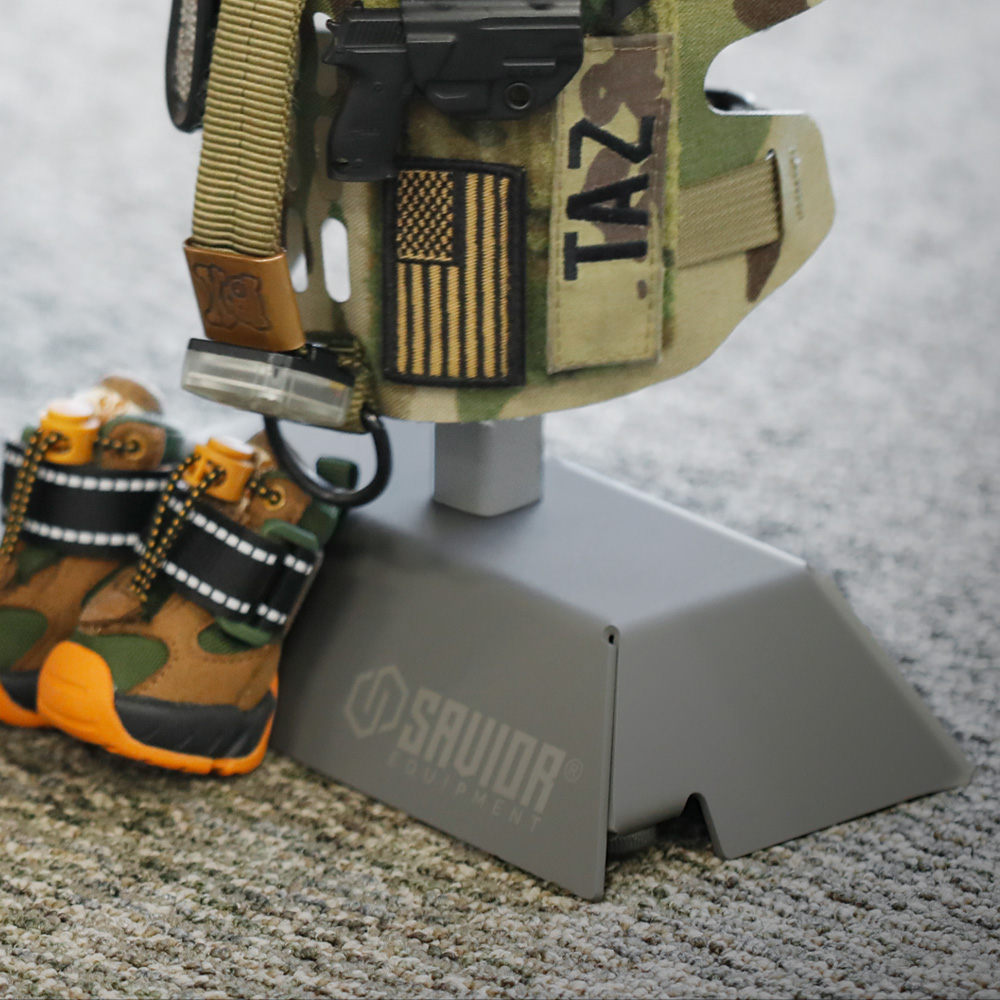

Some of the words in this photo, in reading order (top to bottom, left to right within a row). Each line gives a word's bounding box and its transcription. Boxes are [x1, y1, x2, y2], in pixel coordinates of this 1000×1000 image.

[564, 115, 656, 281] TAZ
[387, 751, 543, 833] EQUIPMENT
[397, 686, 567, 814] SAVIOR
